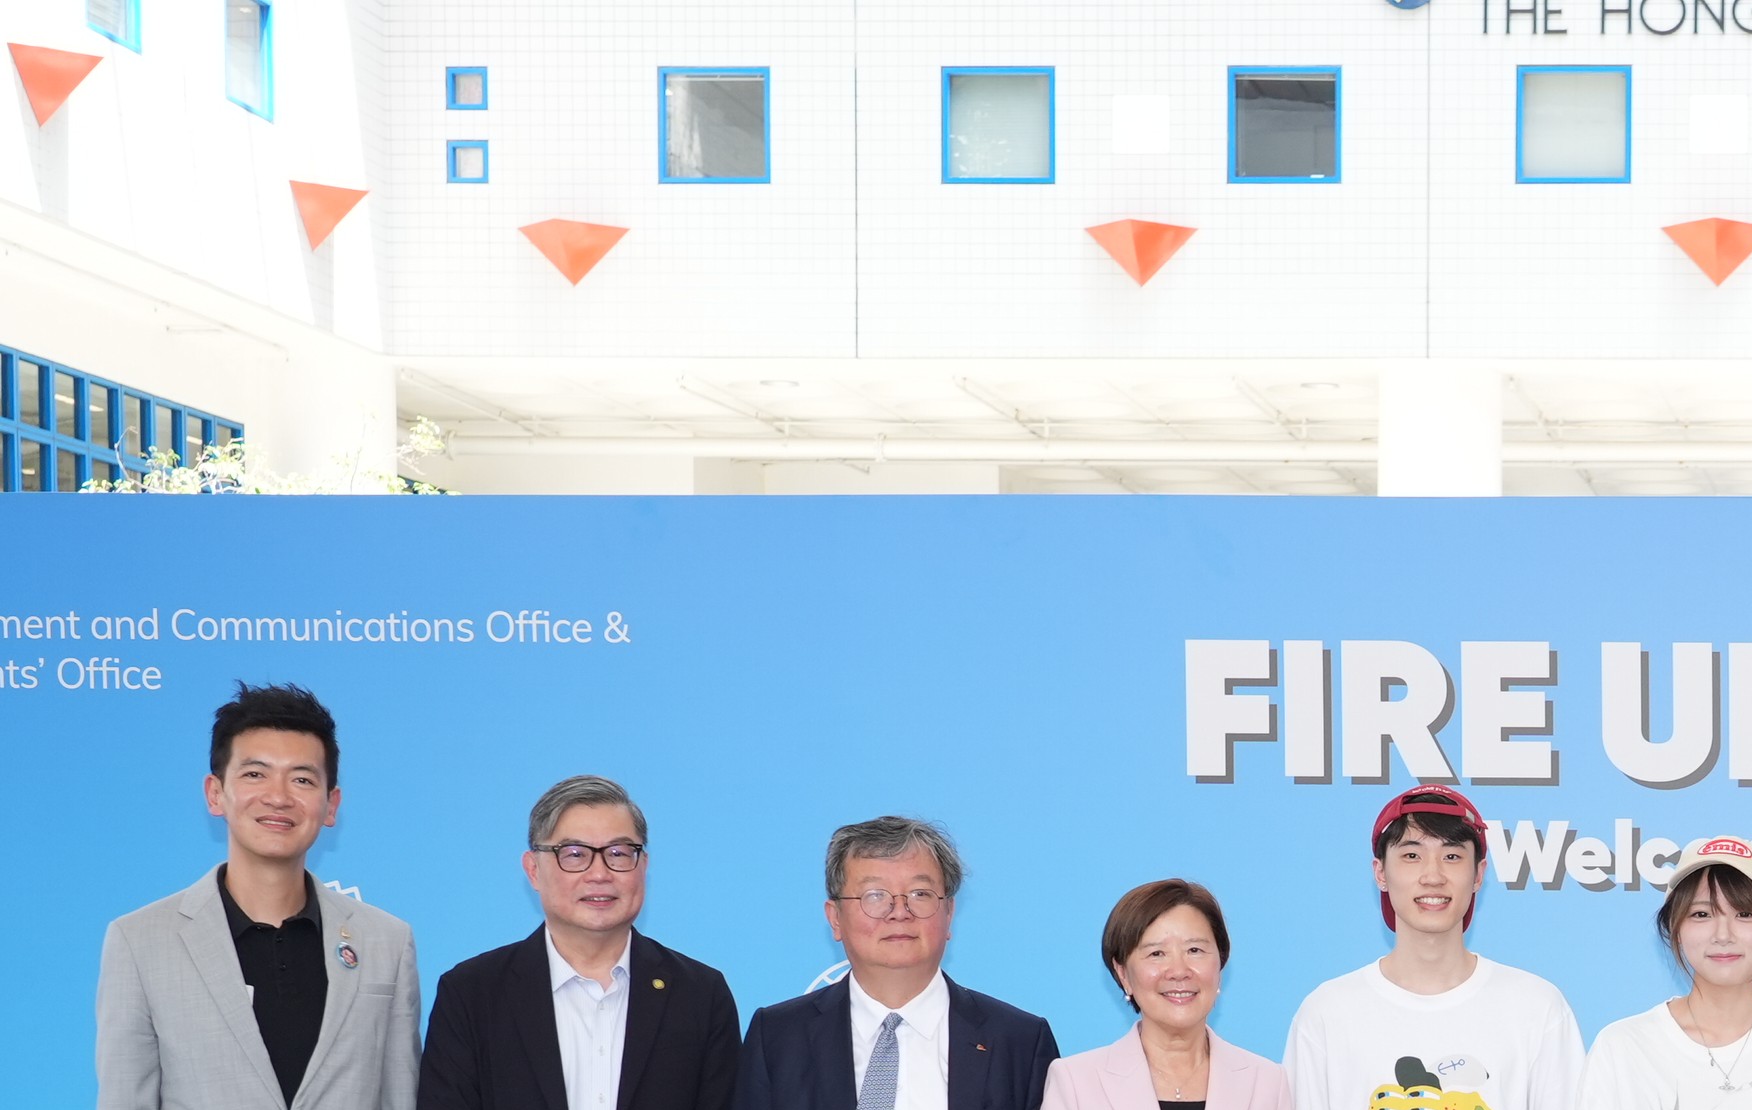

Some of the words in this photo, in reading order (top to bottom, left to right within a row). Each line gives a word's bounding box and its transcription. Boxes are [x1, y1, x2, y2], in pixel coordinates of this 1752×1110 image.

[90, 607, 160, 641] and
[170, 608, 474, 643] Communications
[485, 610, 592, 643] Office
[602, 611, 631, 644] &
[56, 656, 163, 691] Office
[1184, 638, 1555, 783] FIRE
